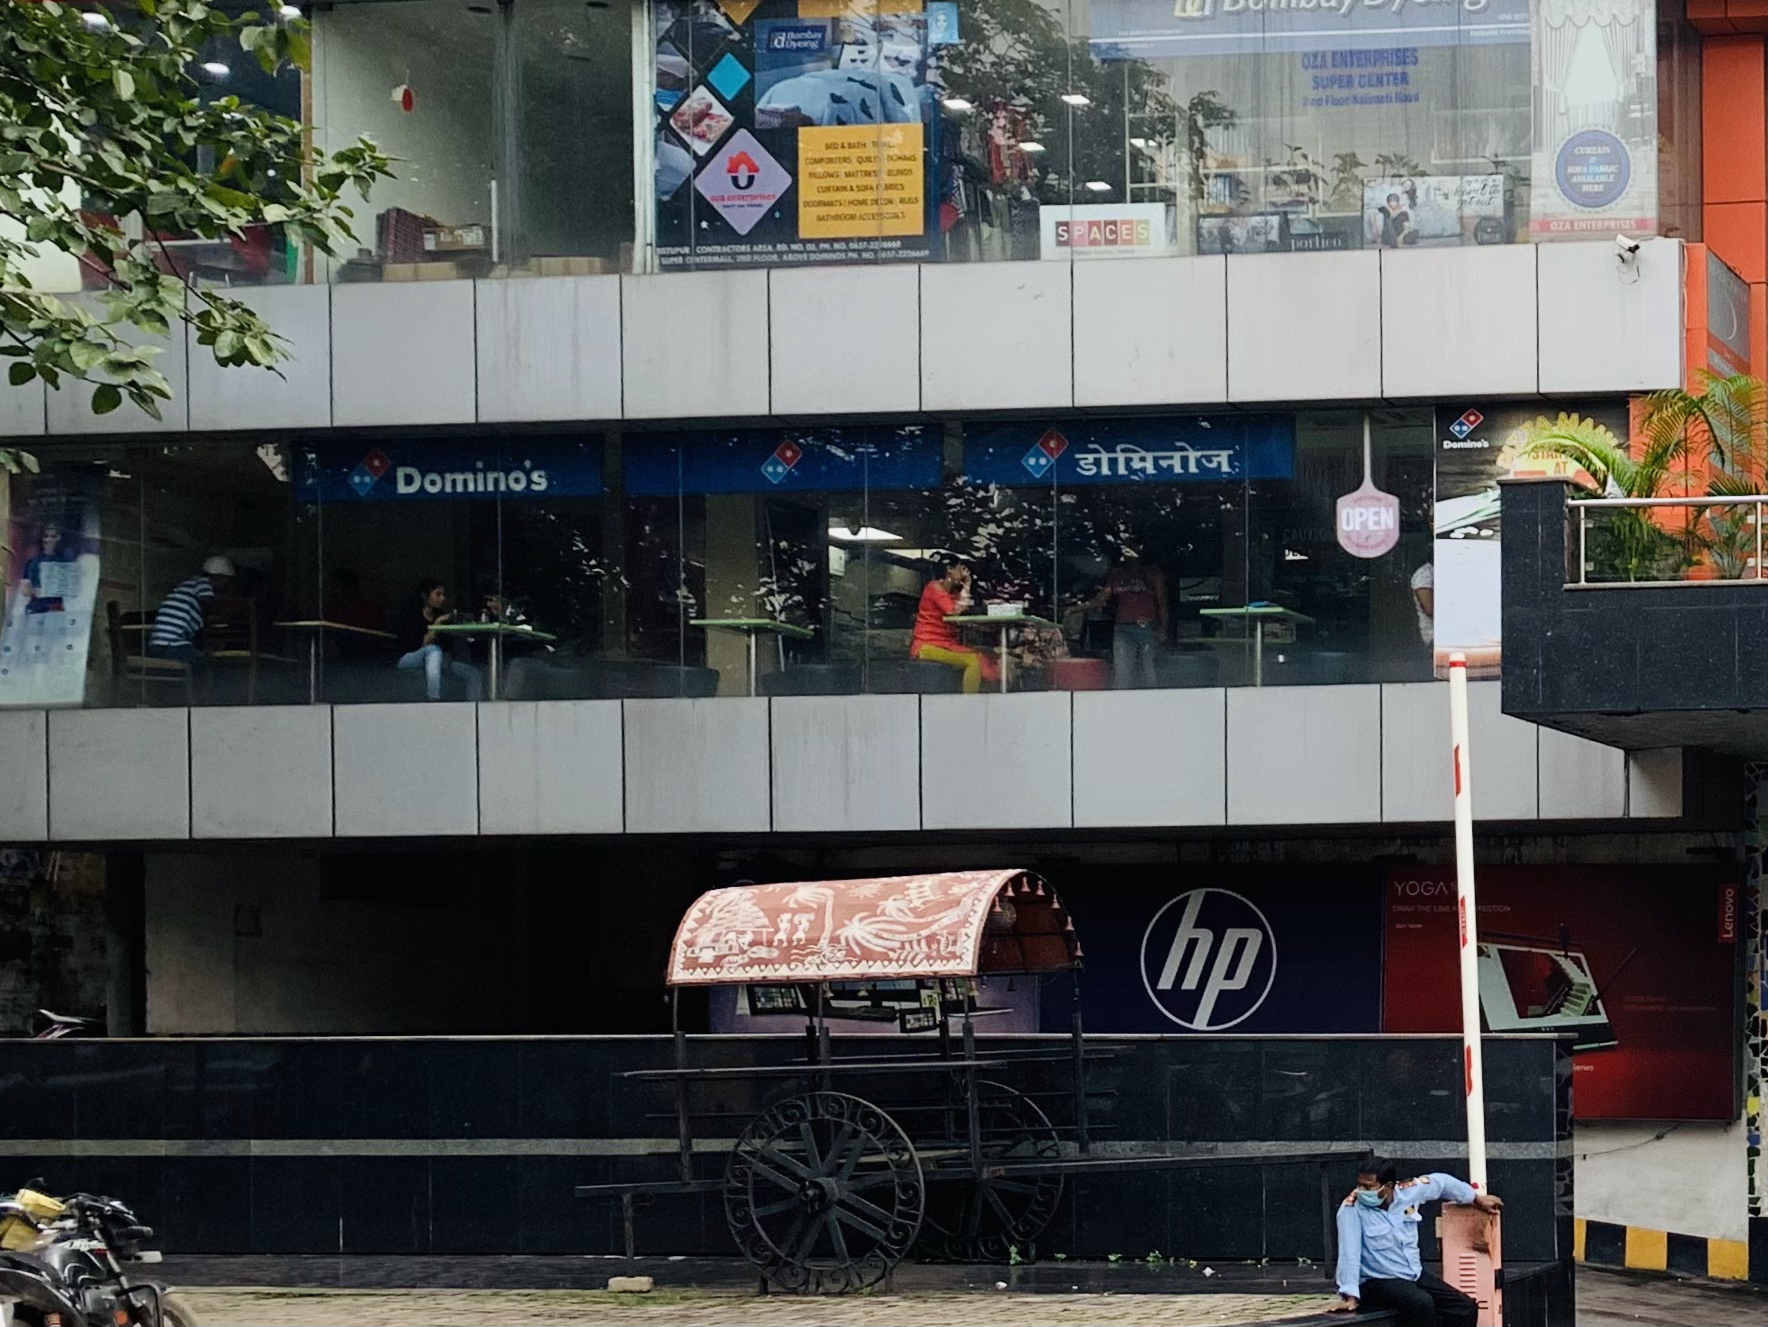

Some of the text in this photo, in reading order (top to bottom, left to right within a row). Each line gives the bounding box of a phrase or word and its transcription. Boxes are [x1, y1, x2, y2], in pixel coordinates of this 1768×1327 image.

[785, 40, 819, 50] Dyeing
[787, 30, 822, 41] Bombay
[1301, 47, 1419, 70] OZA ENTERPRISES
[1312, 72, 1410, 90] SUPER CENTER
[1574, 145, 1612, 154] CURTAIN
[1057, 222, 1150, 242] SPACES
[1550, 219, 1637, 230] OZA ENTERPRISES
[1443, 438, 1490, 450] Domino's
[1075, 441, 1234, 476] डोमिनोज
[396, 460, 549, 496] Domino's
[1341, 506, 1394, 532] OPEN
[1393, 880, 1449, 896] YOGA
[1722, 888, 1734, 938] Lenovo
[1156, 888, 1264, 1031] hp
